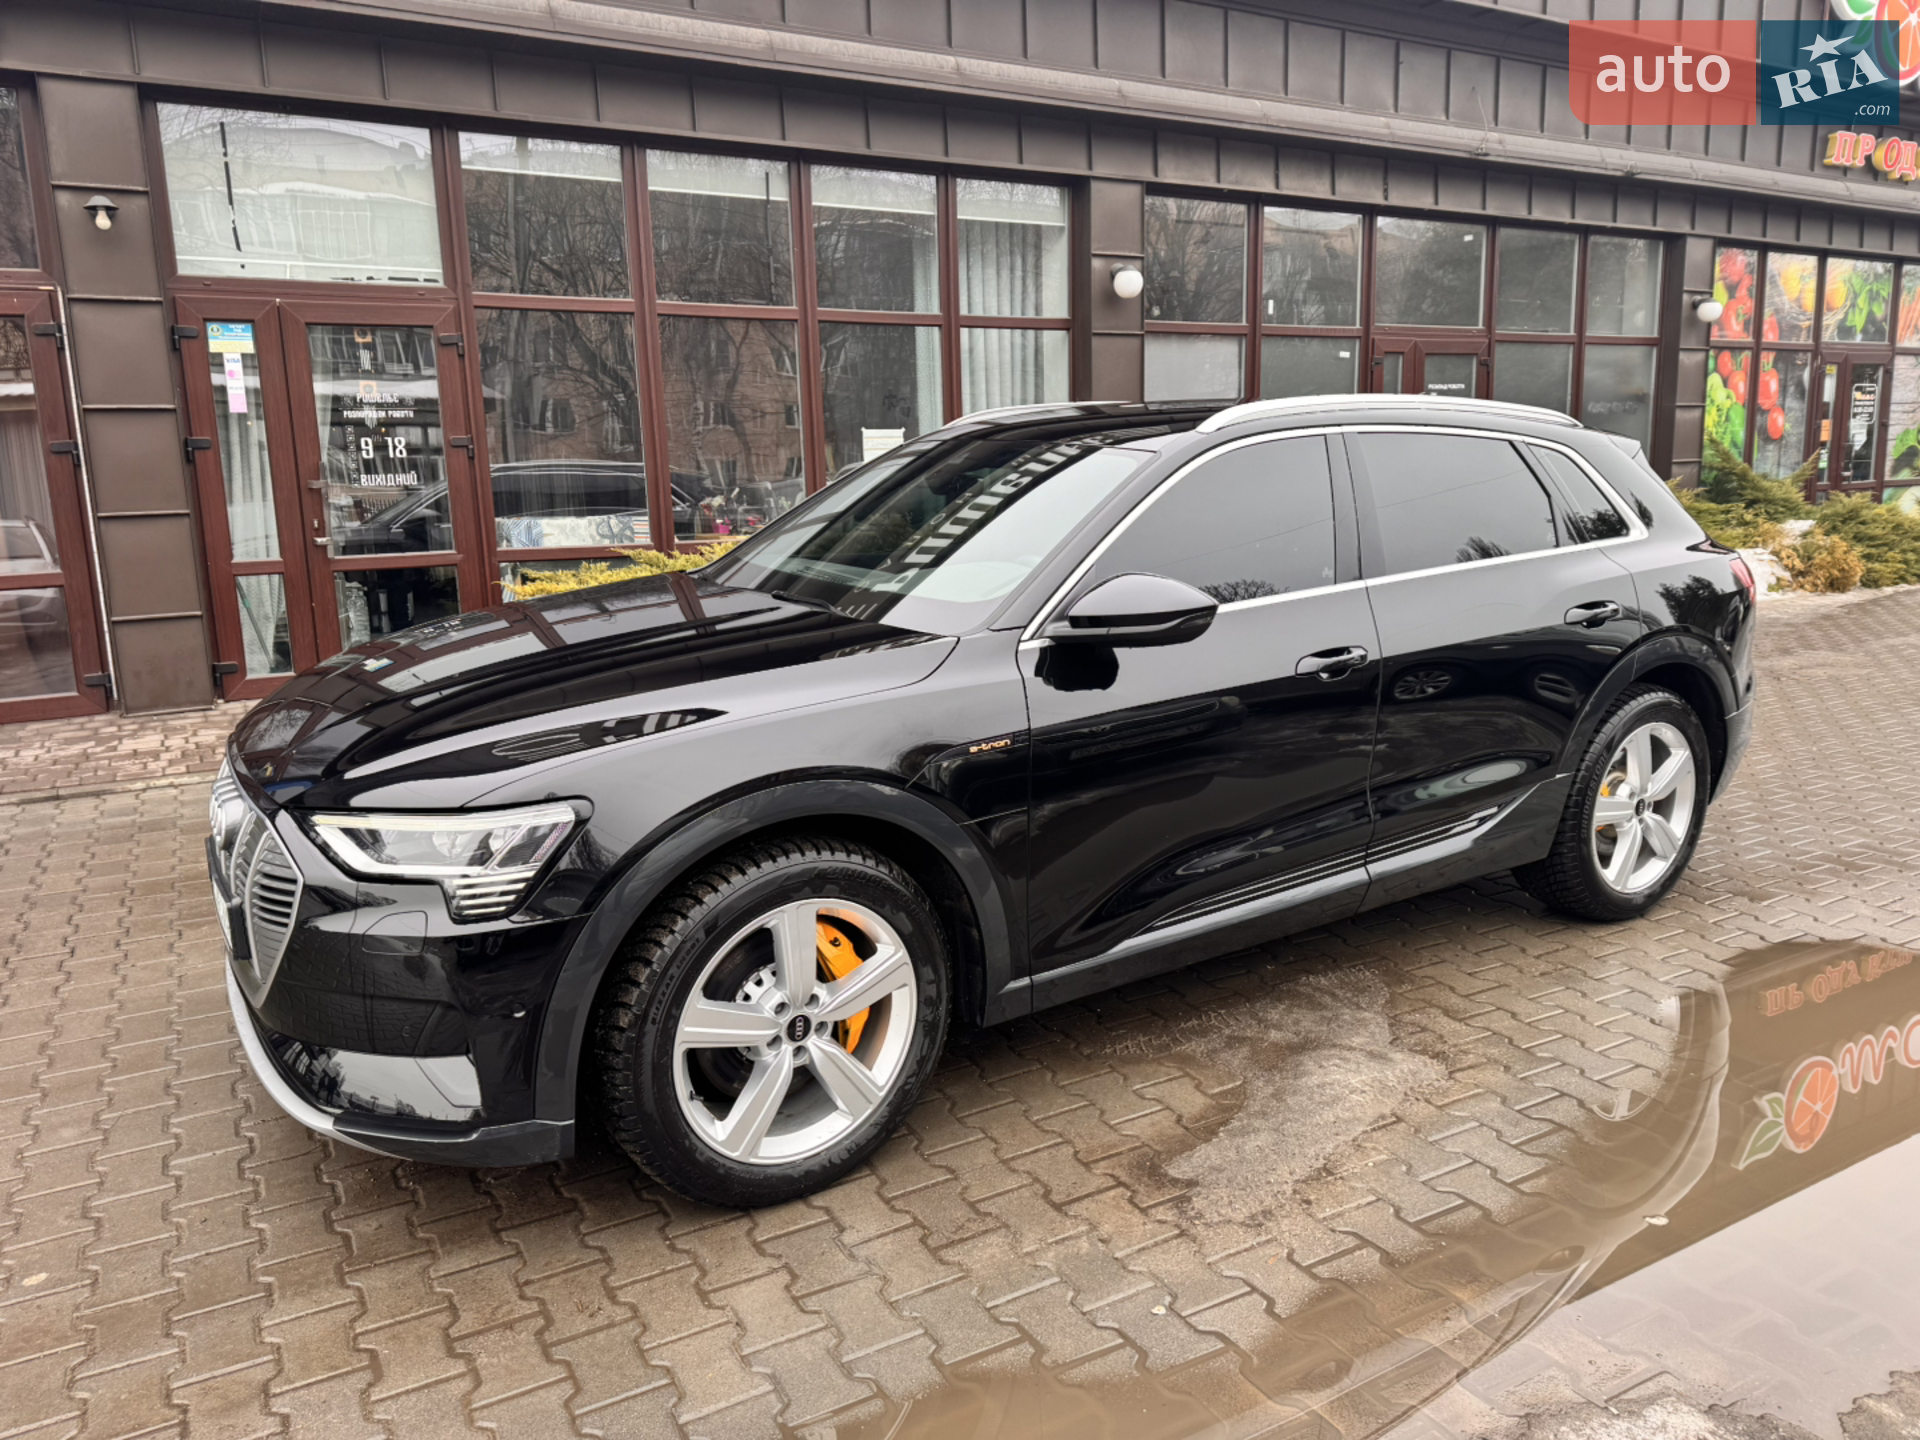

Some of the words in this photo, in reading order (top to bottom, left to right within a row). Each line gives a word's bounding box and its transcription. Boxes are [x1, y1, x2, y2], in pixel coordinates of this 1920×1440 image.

[360, 436, 375, 460] 9
[383, 436, 408, 459] 18
[360, 470, 418, 487] ВИХІДНИЙ
